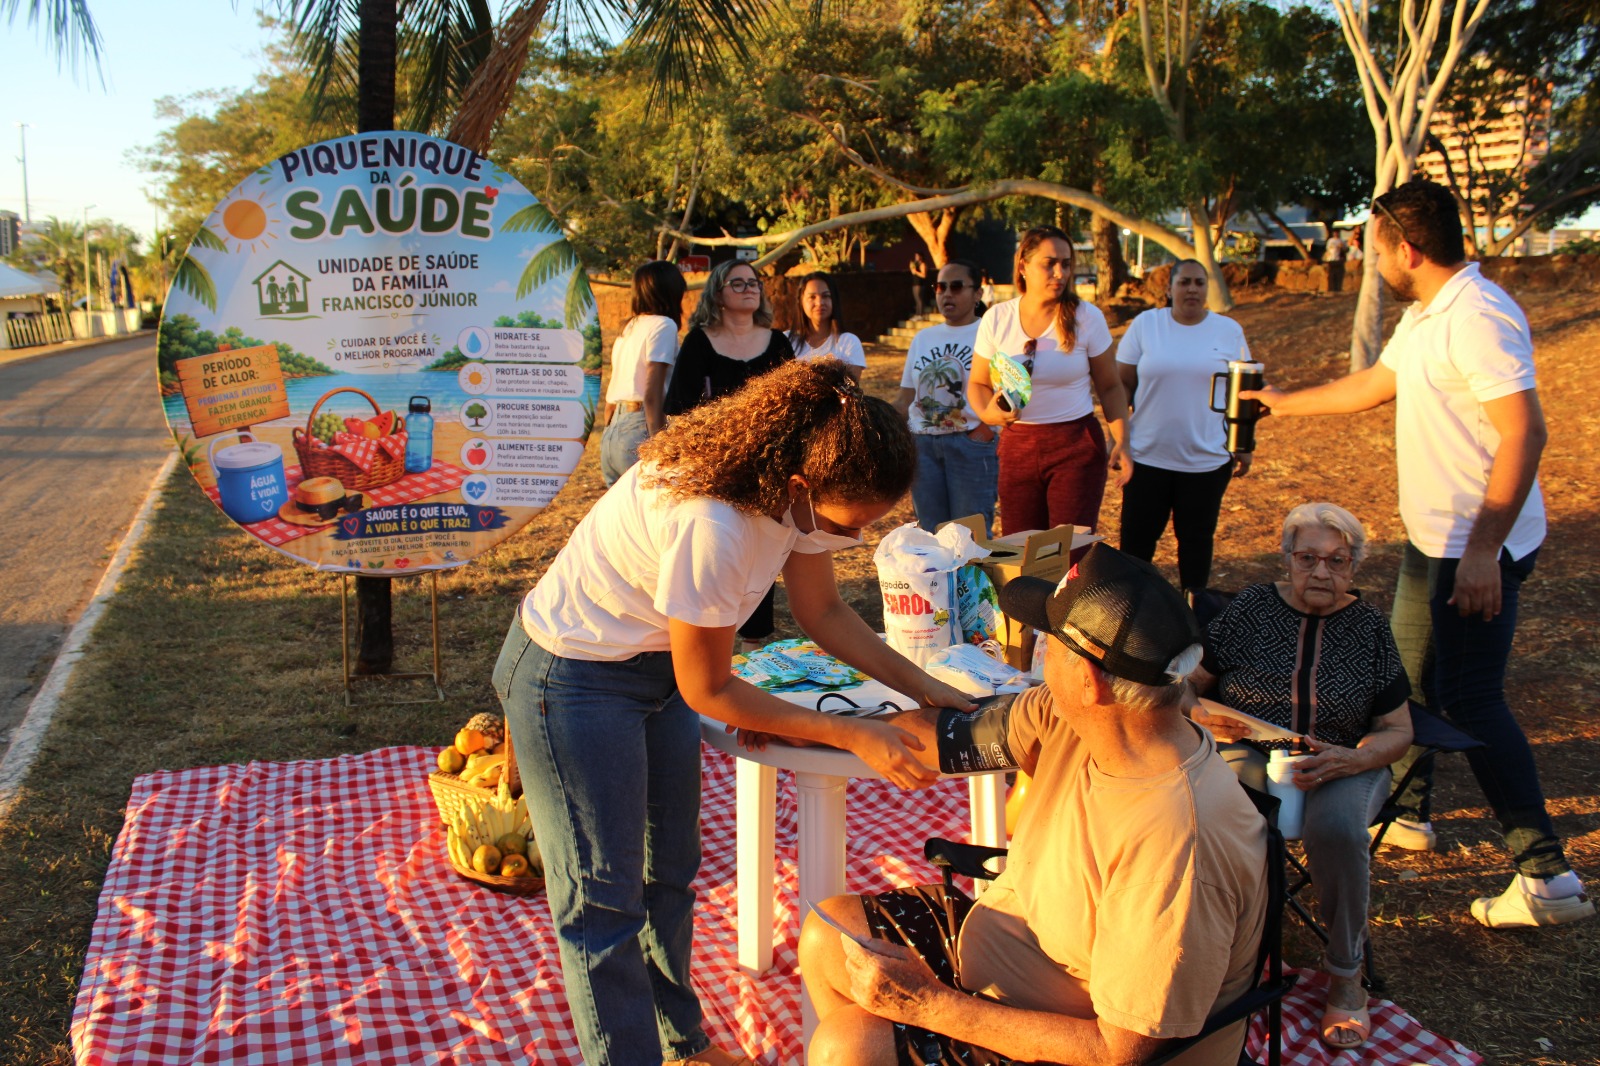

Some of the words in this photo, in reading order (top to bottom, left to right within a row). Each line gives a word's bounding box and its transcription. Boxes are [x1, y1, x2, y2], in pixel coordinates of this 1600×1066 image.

[278, 138, 486, 183] PIQUENIQUE
[369, 171, 391, 184] DA
[285, 175, 495, 239] SAÚDE
[318, 257, 393, 274] UNIDADE
[399, 255, 420, 271] DE
[425, 251, 479, 270] SAÚDE
[352, 276, 376, 292] DA
[382, 273, 449, 291] FAMÍLIA
[322, 293, 414, 312] FRANCISCO
[419, 290, 478, 308] JÚNIOR
[341, 337, 376, 348] CUIDAR
[380, 336, 391, 346] DE
[394, 333, 418, 345] VOCÊ
[421, 333, 427, 344] É
[494, 332, 540, 341] HIDRATE-SE
[334, 352, 341, 361] O
[344, 350, 381, 360] MELHOR
[383, 347, 435, 358] PROGRAMA!
[202, 356, 251, 375] PERÍODO
[495, 367, 540, 376] PROTEJA-SE
[542, 368, 553, 377] DO
[202, 377, 218, 389] DE
[221, 370, 260, 386] CALOR:
[197, 390, 240, 407] PEQUENAS
[241, 383, 278, 397] ATITUDES
[208, 402, 237, 416] FAZEM
[239, 394, 272, 409] GRANDE
[496, 403, 529, 411] PROCURE
[531, 403, 560, 412] SOMBRA
[218, 407, 267, 426] DIFERENÇA!
[497, 443, 546, 452] ALIMENTE-SE
[547, 445, 563, 453] BEM
[250, 473, 276, 489] ÁGUA
[496, 477, 529, 486] CUIDE-SE
[531, 478, 559, 487] SEMPRE
[250, 490, 257, 501] É
[257, 485, 279, 498] VIDA!
[365, 508, 399, 521] SAÚDE
[401, 506, 407, 519] É
[409, 508, 418, 518] O
[420, 506, 440, 518] QUE
[441, 505, 469, 517] LEVA,
[365, 524, 373, 534] A
[375, 522, 399, 533] VIDA
[401, 519, 407, 531] É
[409, 520, 418, 531] O
[420, 518, 440, 530] QUE
[442, 517, 470, 528] TRAZ!
[347, 539, 382, 548] APROVEITE
[434, 532, 450, 540] VOCÊ
[360, 546, 381, 554] SAÚDE
[396, 543, 424, 551] MELHOR
[425, 540, 471, 548] COMPANHEIRO!
